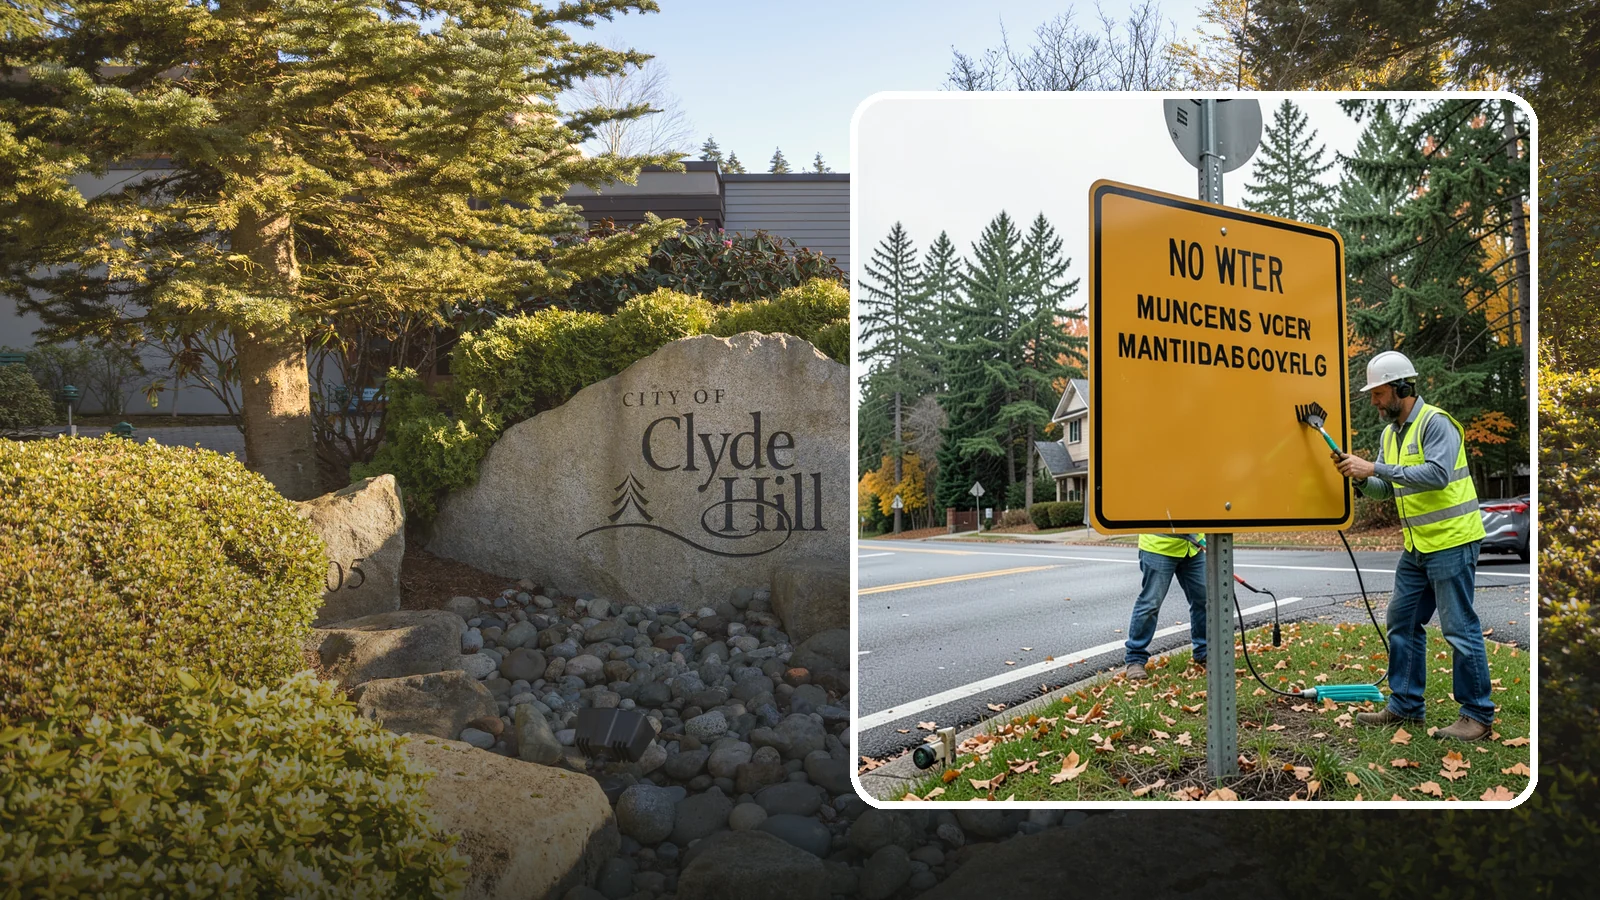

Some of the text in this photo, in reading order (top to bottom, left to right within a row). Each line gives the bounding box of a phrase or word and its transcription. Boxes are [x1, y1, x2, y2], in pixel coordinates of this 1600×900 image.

[1169, 237, 1284, 294] NO WTER
[1137, 293, 1251, 333] MUNCENS
[622, 388, 725, 407] CITY OF
[642, 410, 795, 493] Clyde
[719, 472, 828, 532] Hill
